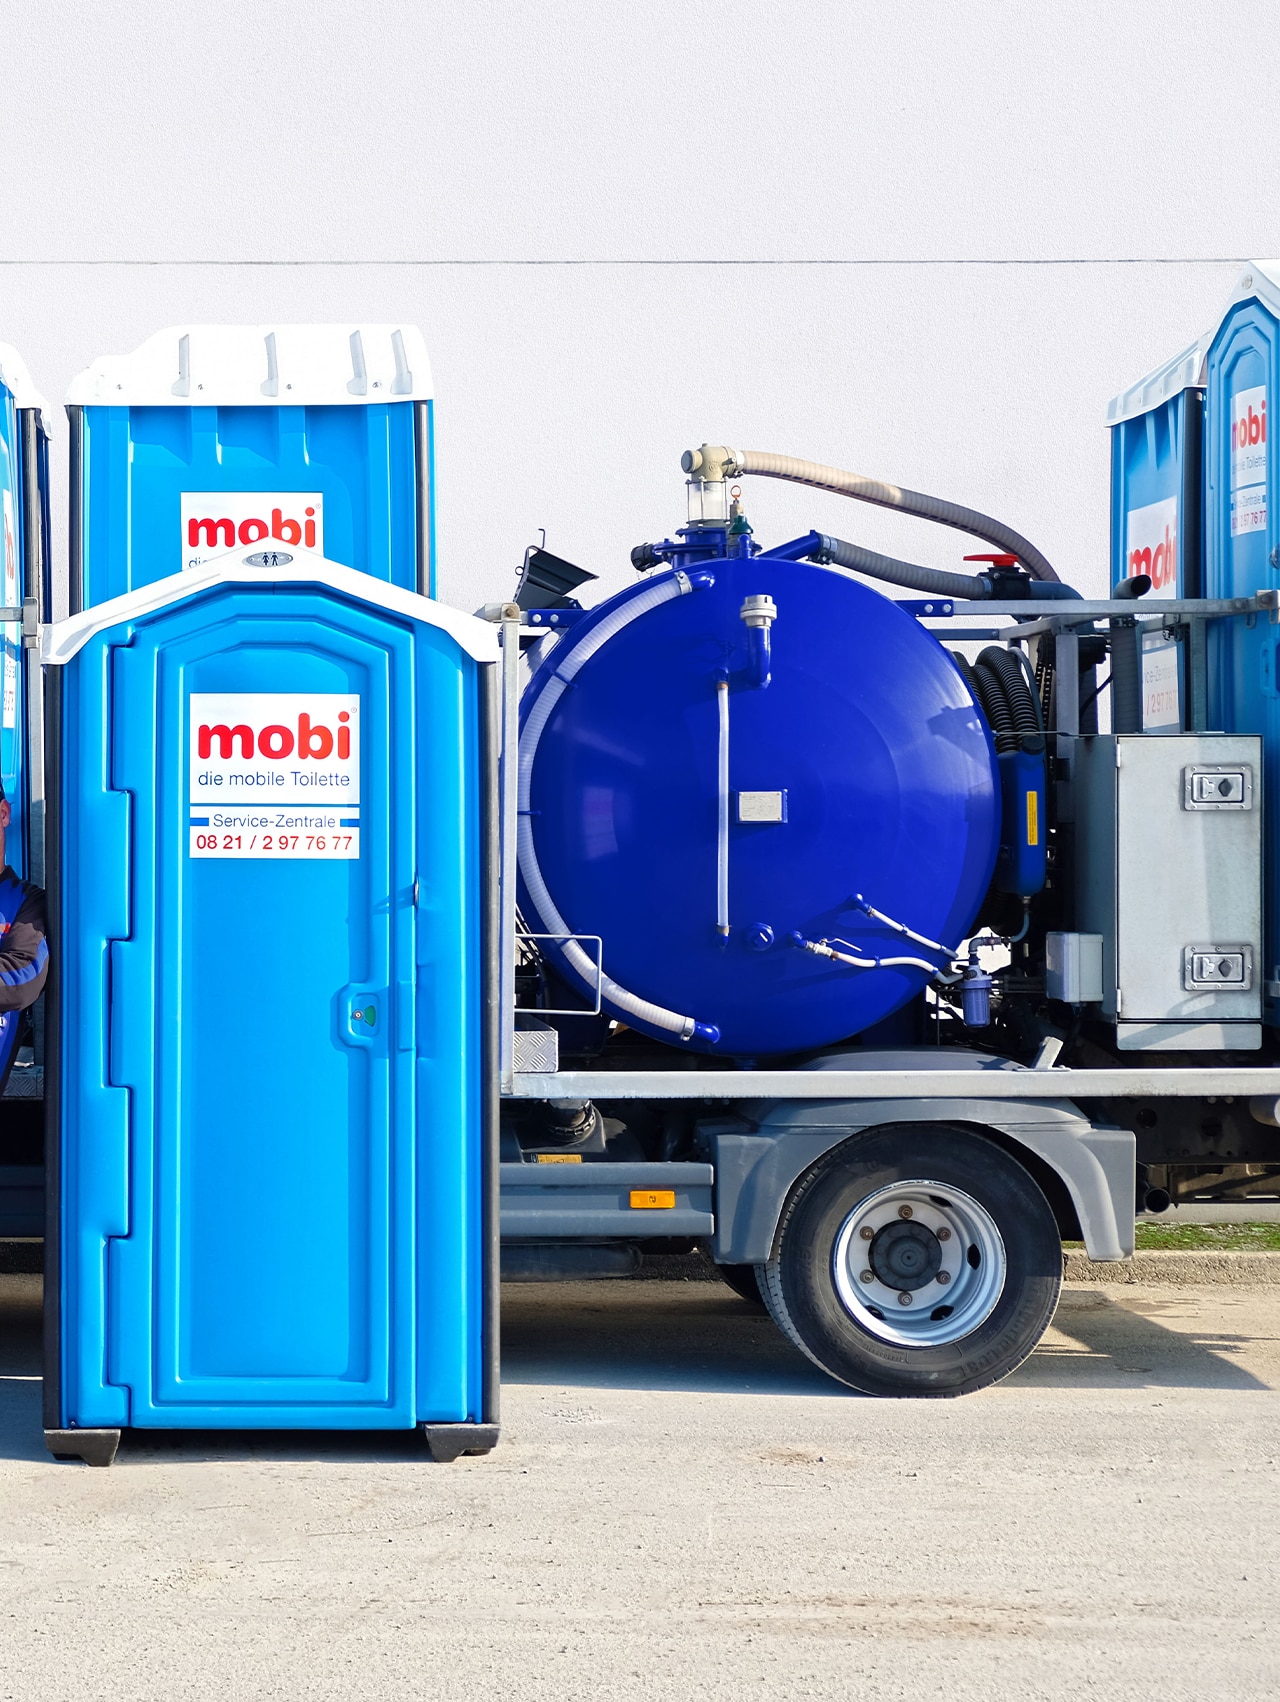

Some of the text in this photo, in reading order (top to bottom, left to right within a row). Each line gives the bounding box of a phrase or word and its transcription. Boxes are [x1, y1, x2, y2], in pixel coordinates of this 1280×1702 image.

[188, 506, 316, 548] mobi
[197, 710, 351, 760] mobi
[198, 771, 351, 787] die mobile Toilette
[213, 813, 336, 829] Service-Zentrale
[196, 834, 218, 850] 08
[222, 834, 242, 850] 21
[262, 834, 273, 850] 2
[278, 835, 300, 850] 97
[305, 835, 326, 850] 76
[332, 835, 353, 850] 77
